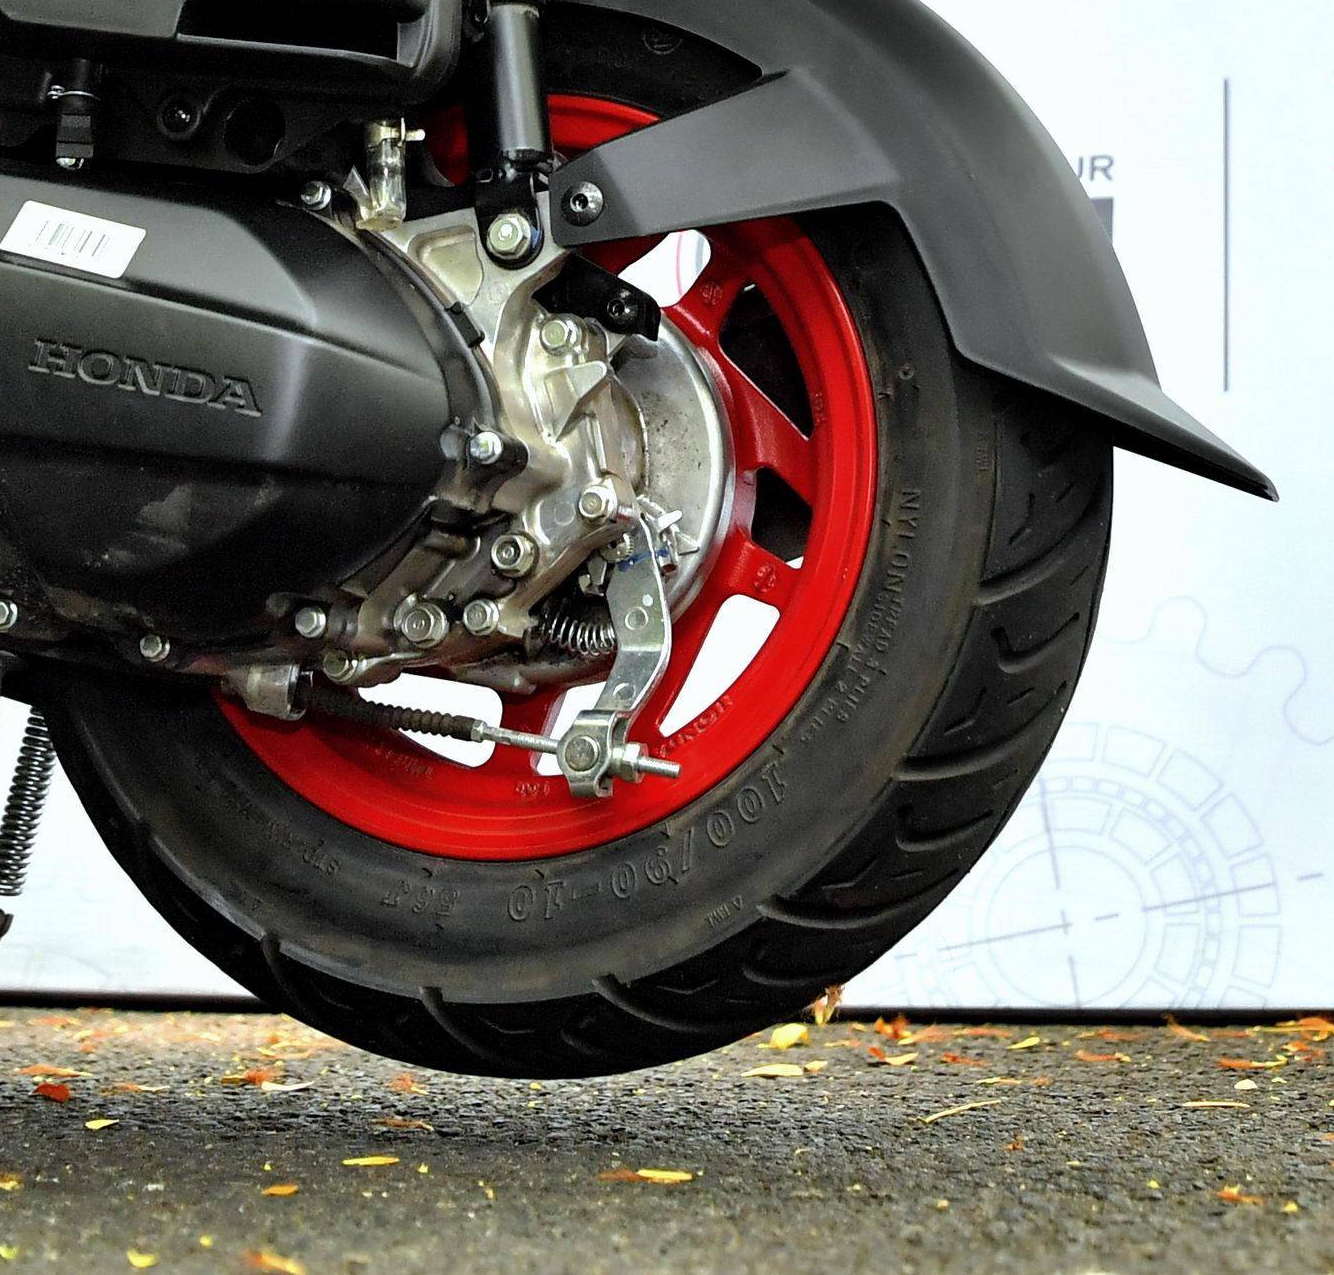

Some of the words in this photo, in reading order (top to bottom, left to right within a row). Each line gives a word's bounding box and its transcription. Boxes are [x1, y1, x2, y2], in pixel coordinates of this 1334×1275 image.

[28, 336, 263, 417] HONDA
[882, 488, 920, 596] NYLON
[507, 761, 787, 921] 100/90-10
